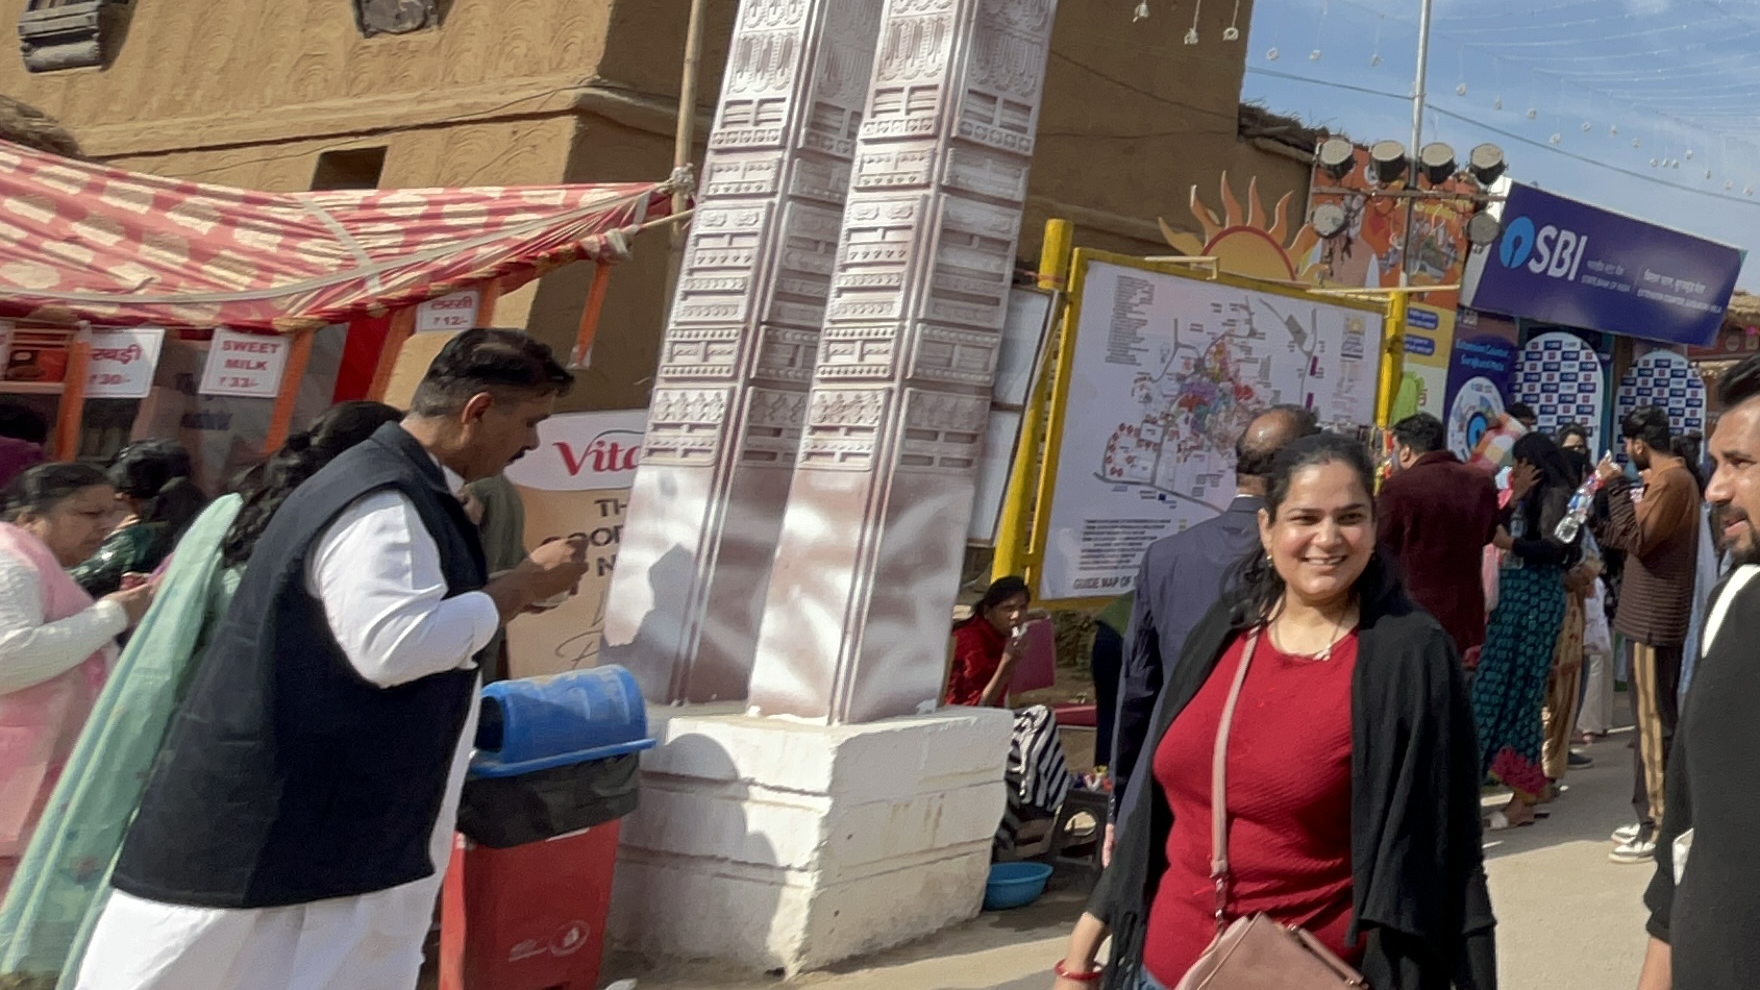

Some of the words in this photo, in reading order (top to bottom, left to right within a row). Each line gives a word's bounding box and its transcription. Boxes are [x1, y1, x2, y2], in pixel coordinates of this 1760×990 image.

[1528, 225, 1588, 281] SBI
[222, 340, 281, 355] SWEET
[225, 358, 268, 371] MILK
